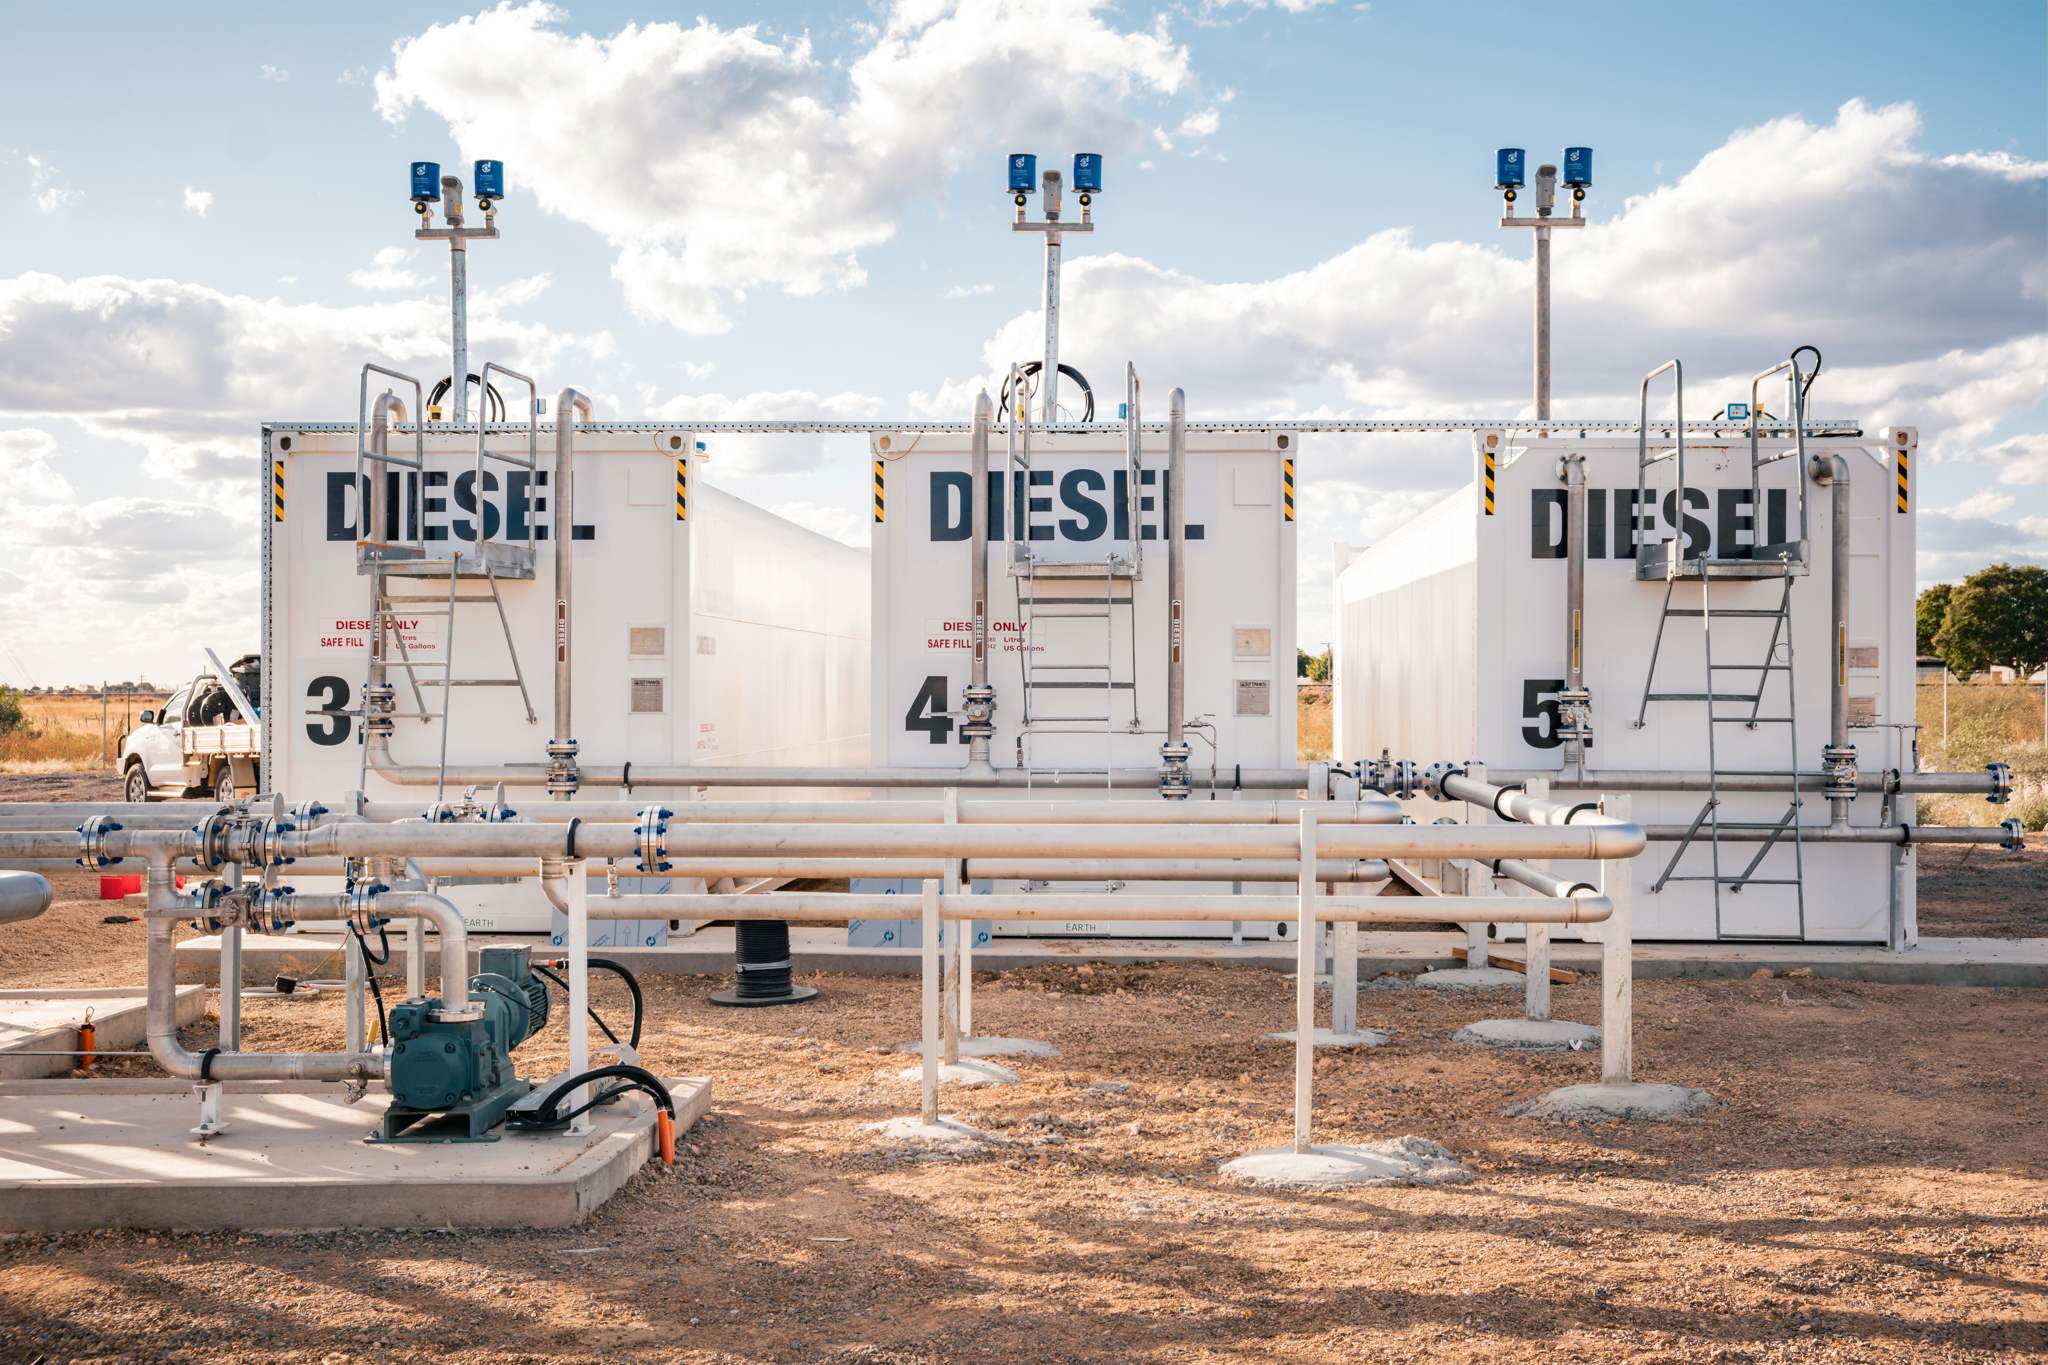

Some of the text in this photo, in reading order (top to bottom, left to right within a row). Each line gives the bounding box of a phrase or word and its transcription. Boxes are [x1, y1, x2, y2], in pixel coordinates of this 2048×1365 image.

[335, 620, 371, 630] DIESE
[943, 622, 1028, 632] DIES ONLY
[320, 637, 365, 647] SAFE FILL
[927, 639, 972, 648] SAFE FILL
[464, 918, 494, 928] EARTH
[1065, 922, 1096, 932] EARTH
